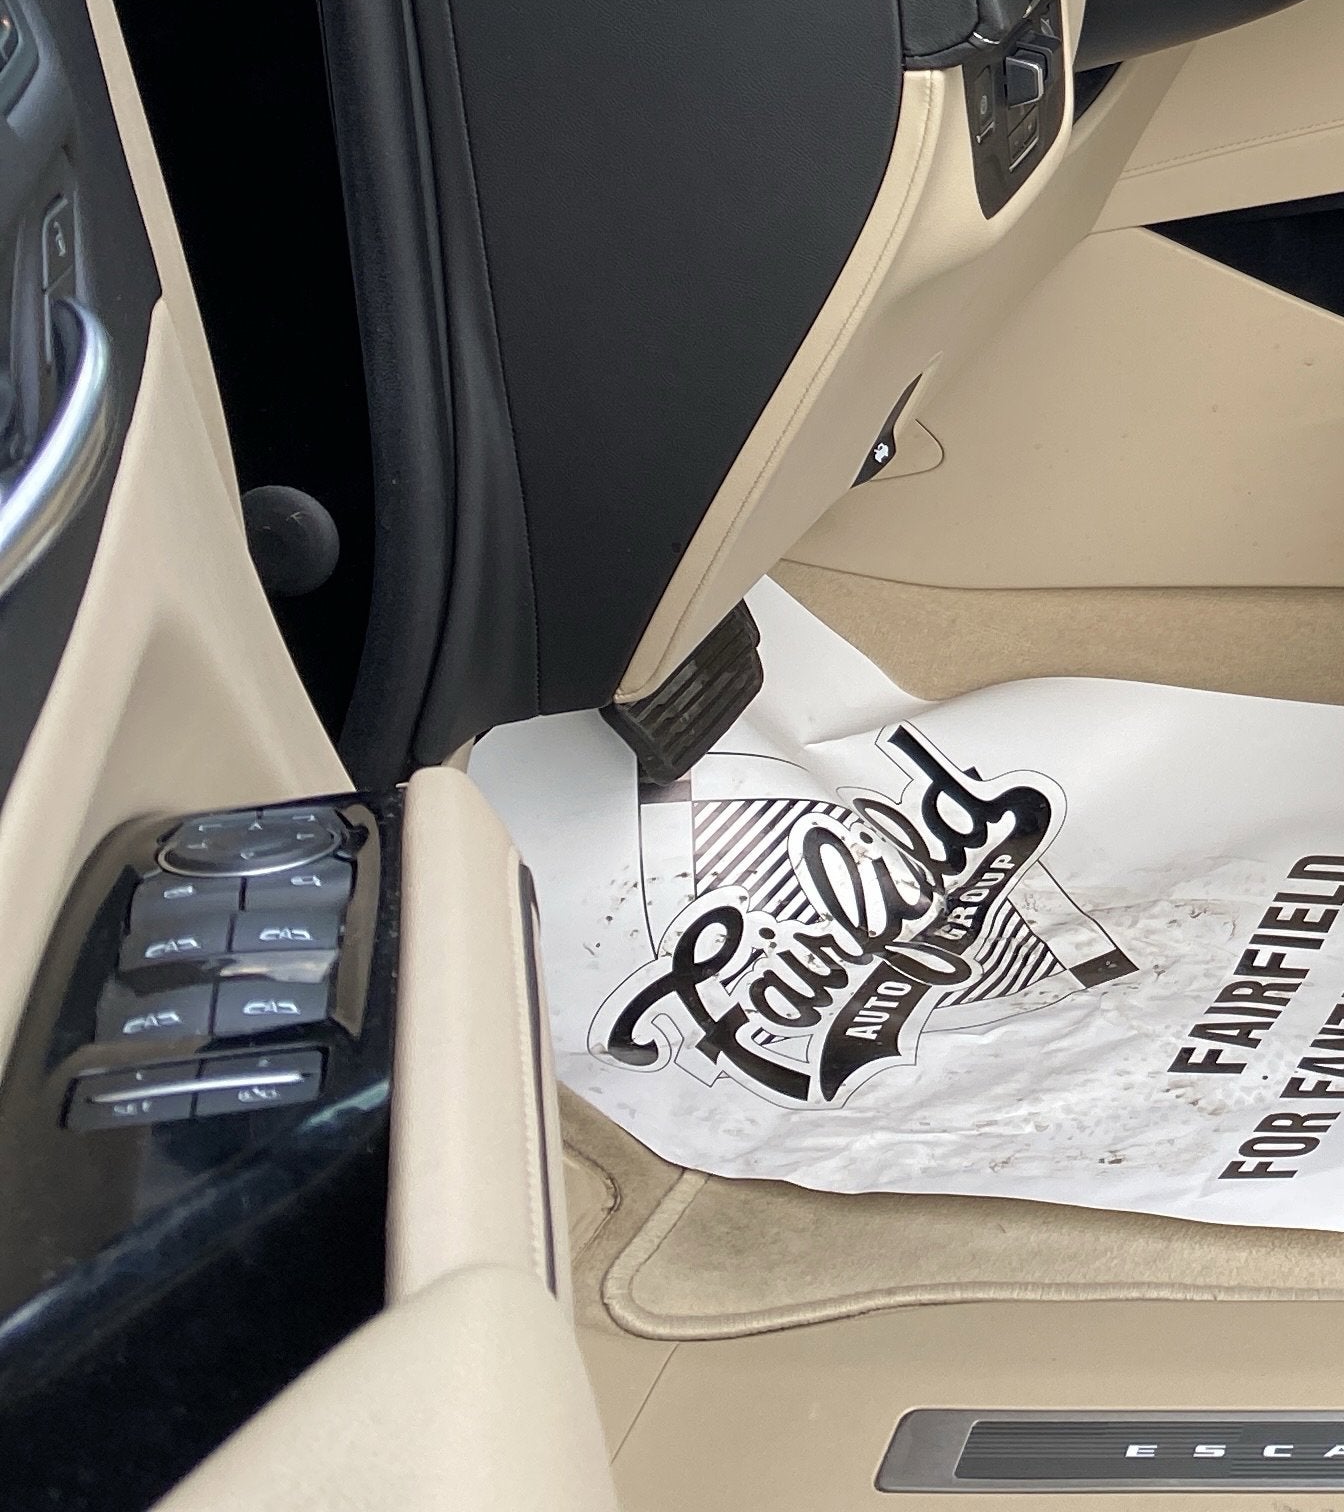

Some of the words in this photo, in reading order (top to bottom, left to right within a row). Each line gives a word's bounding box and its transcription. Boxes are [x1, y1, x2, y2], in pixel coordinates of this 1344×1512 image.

[845, 981, 907, 1040] AUTO
[942, 853, 1017, 944] GROUP
[1217, 1111, 1341, 1179] FOR
